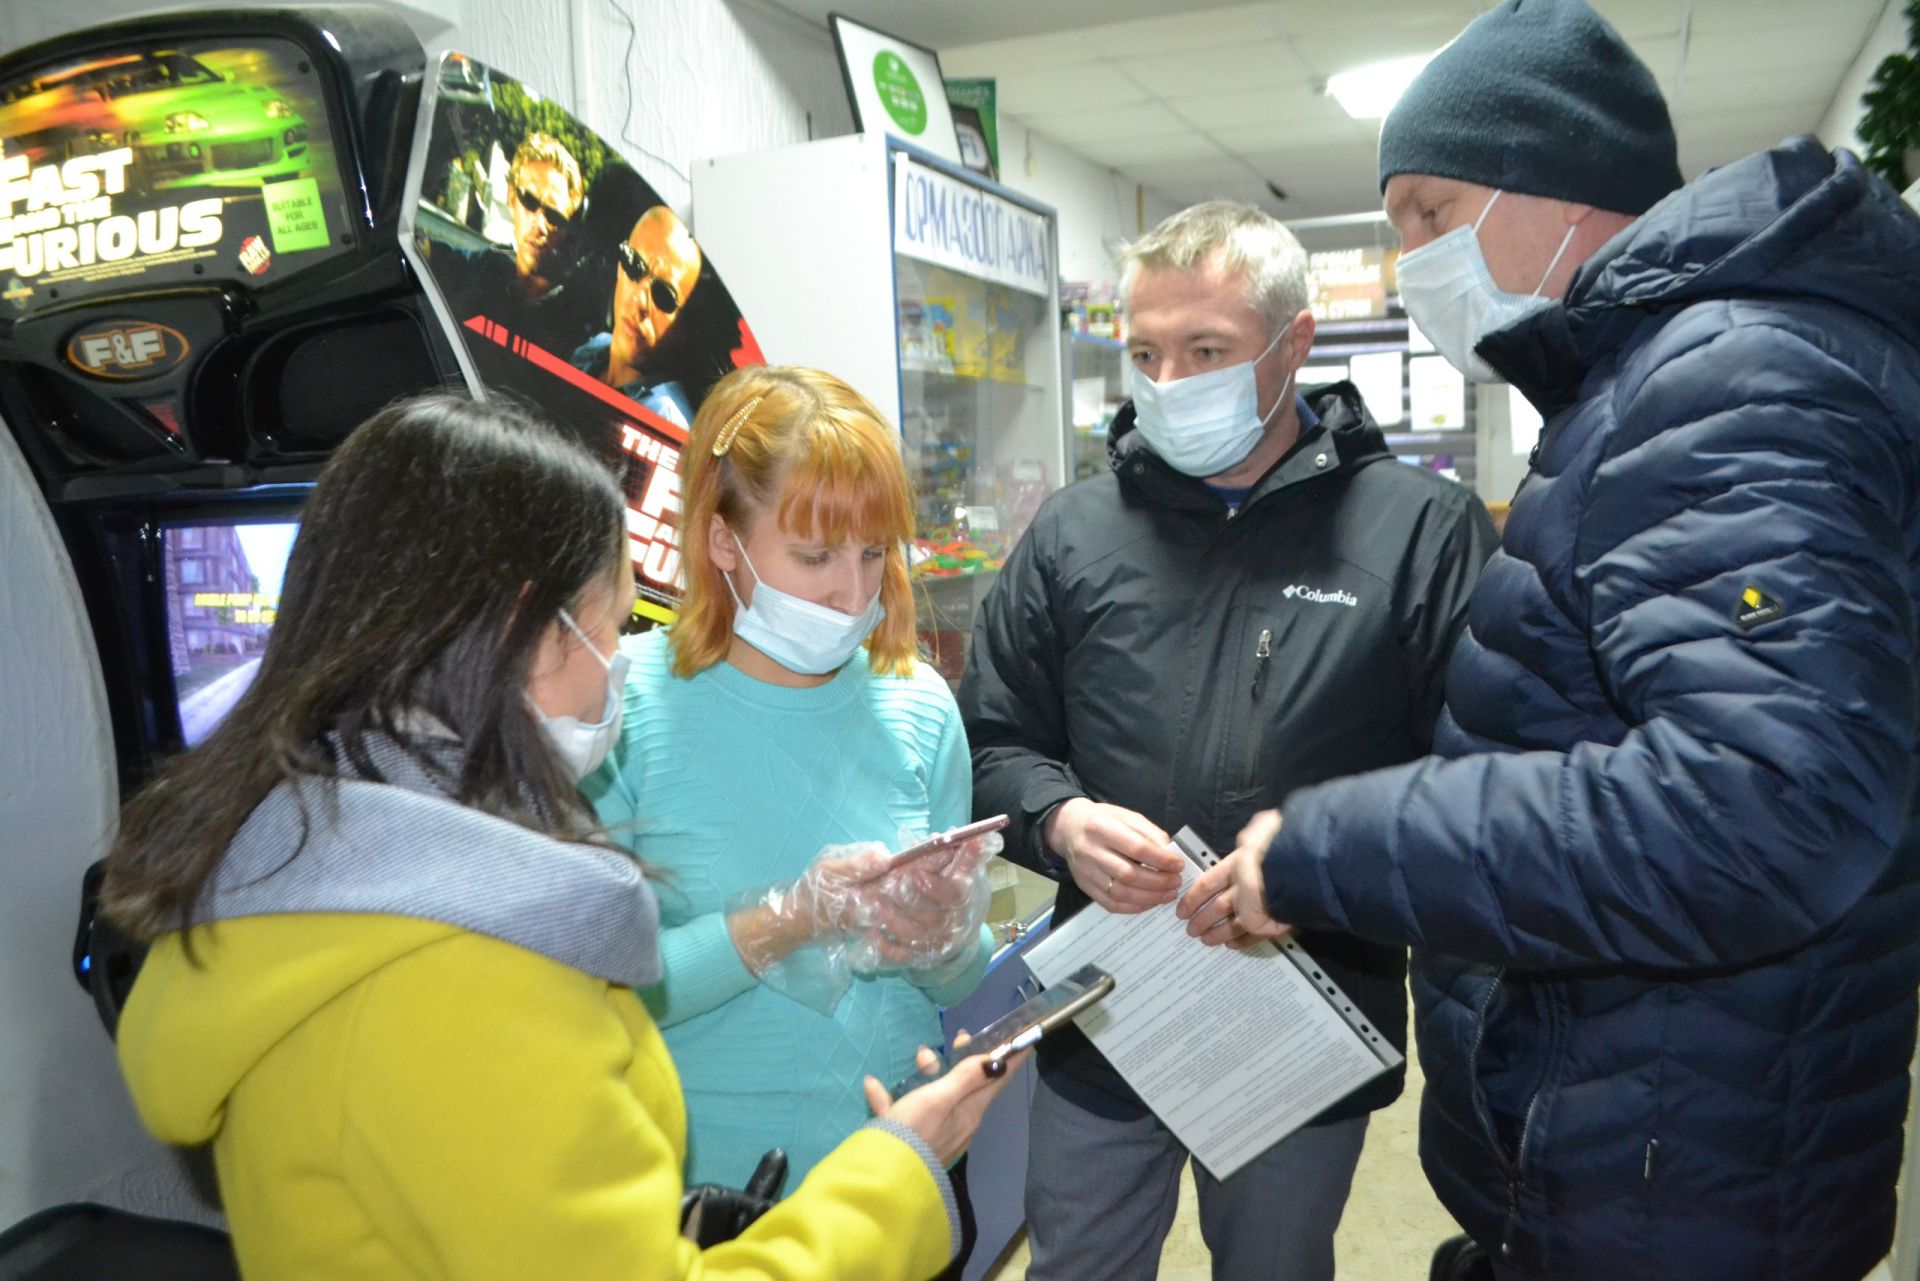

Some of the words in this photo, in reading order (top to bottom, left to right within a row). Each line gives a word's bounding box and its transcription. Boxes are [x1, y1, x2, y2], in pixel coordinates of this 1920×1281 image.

[272, 197, 313, 211] SUITABLE
[286, 210, 304, 221] FOR
[277, 224, 292, 235] ALL
[295, 220, 319, 232] AGES
[83, 330, 161, 368] F&F
[621, 424, 680, 471] THE
[1295, 585, 1358, 607] Columbia
